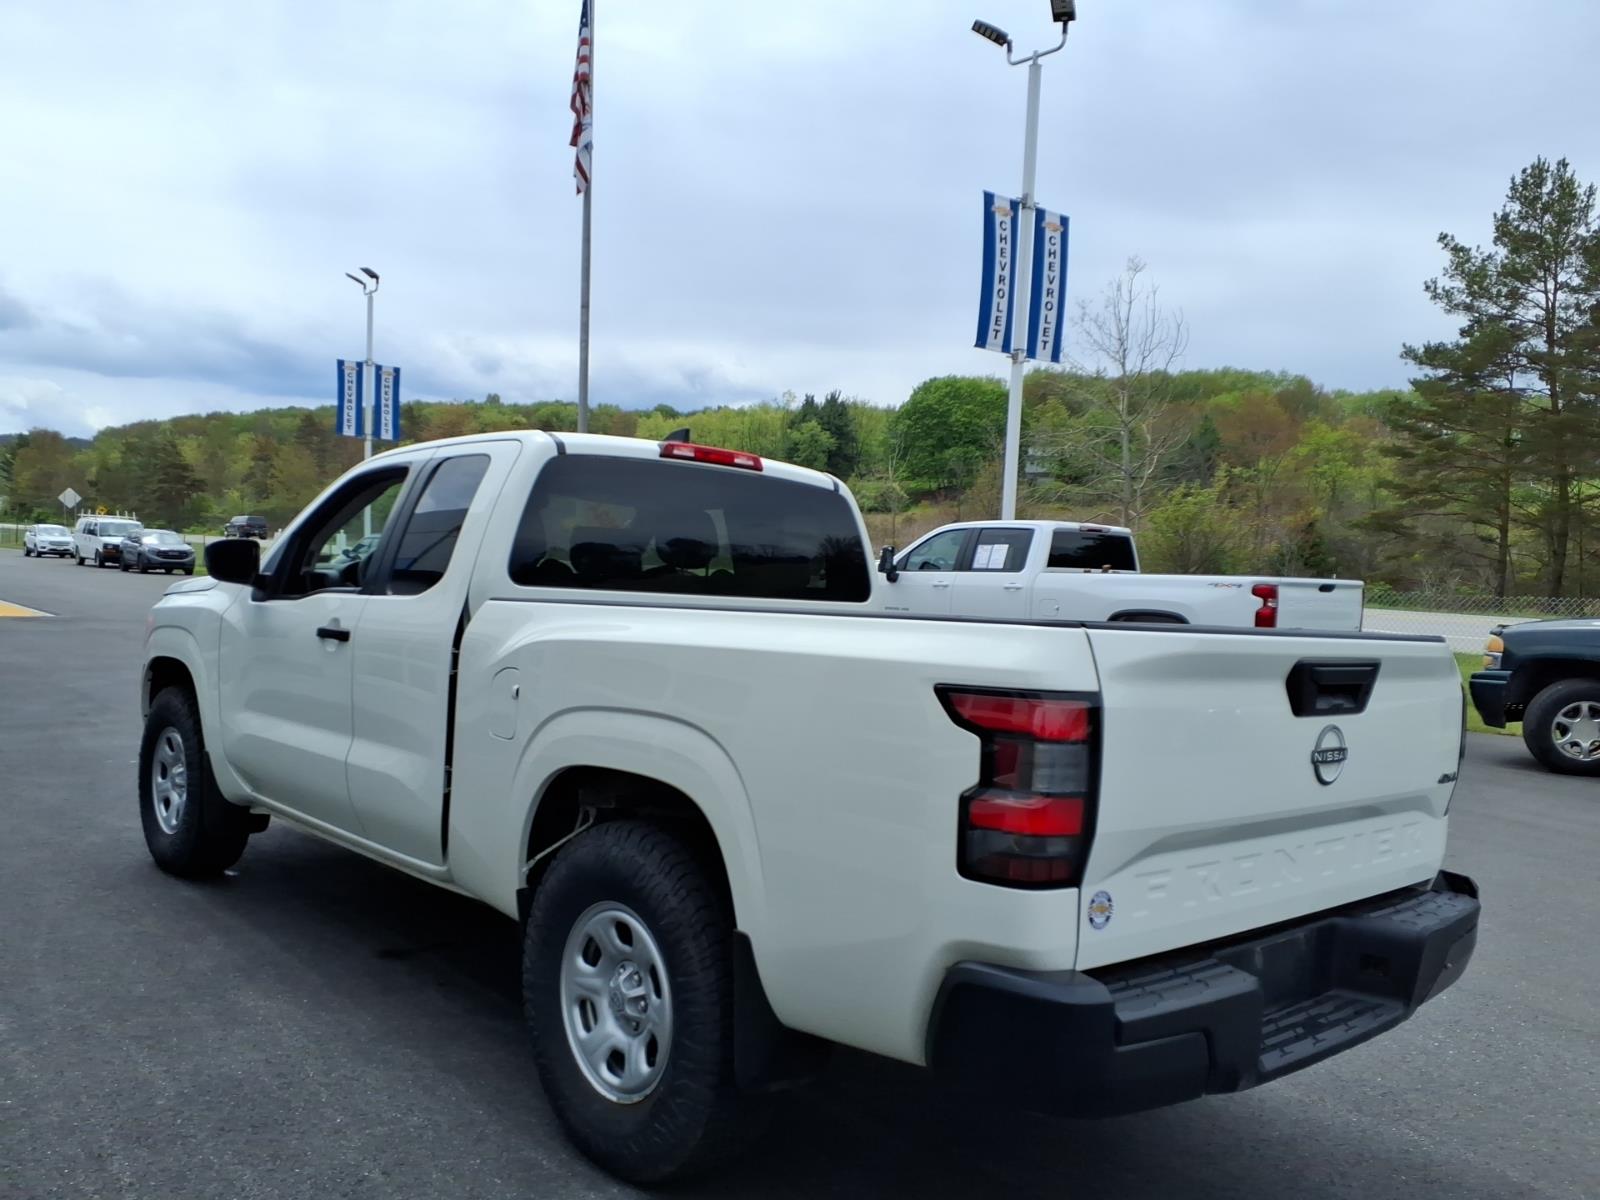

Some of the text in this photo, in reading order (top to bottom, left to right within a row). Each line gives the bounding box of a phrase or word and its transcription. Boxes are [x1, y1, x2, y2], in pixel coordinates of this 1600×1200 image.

[992, 221, 1008, 340] CHEVROLET
[1041, 235, 1057, 350] CHEVROLET
[1314, 751, 1346, 762] NISSA
